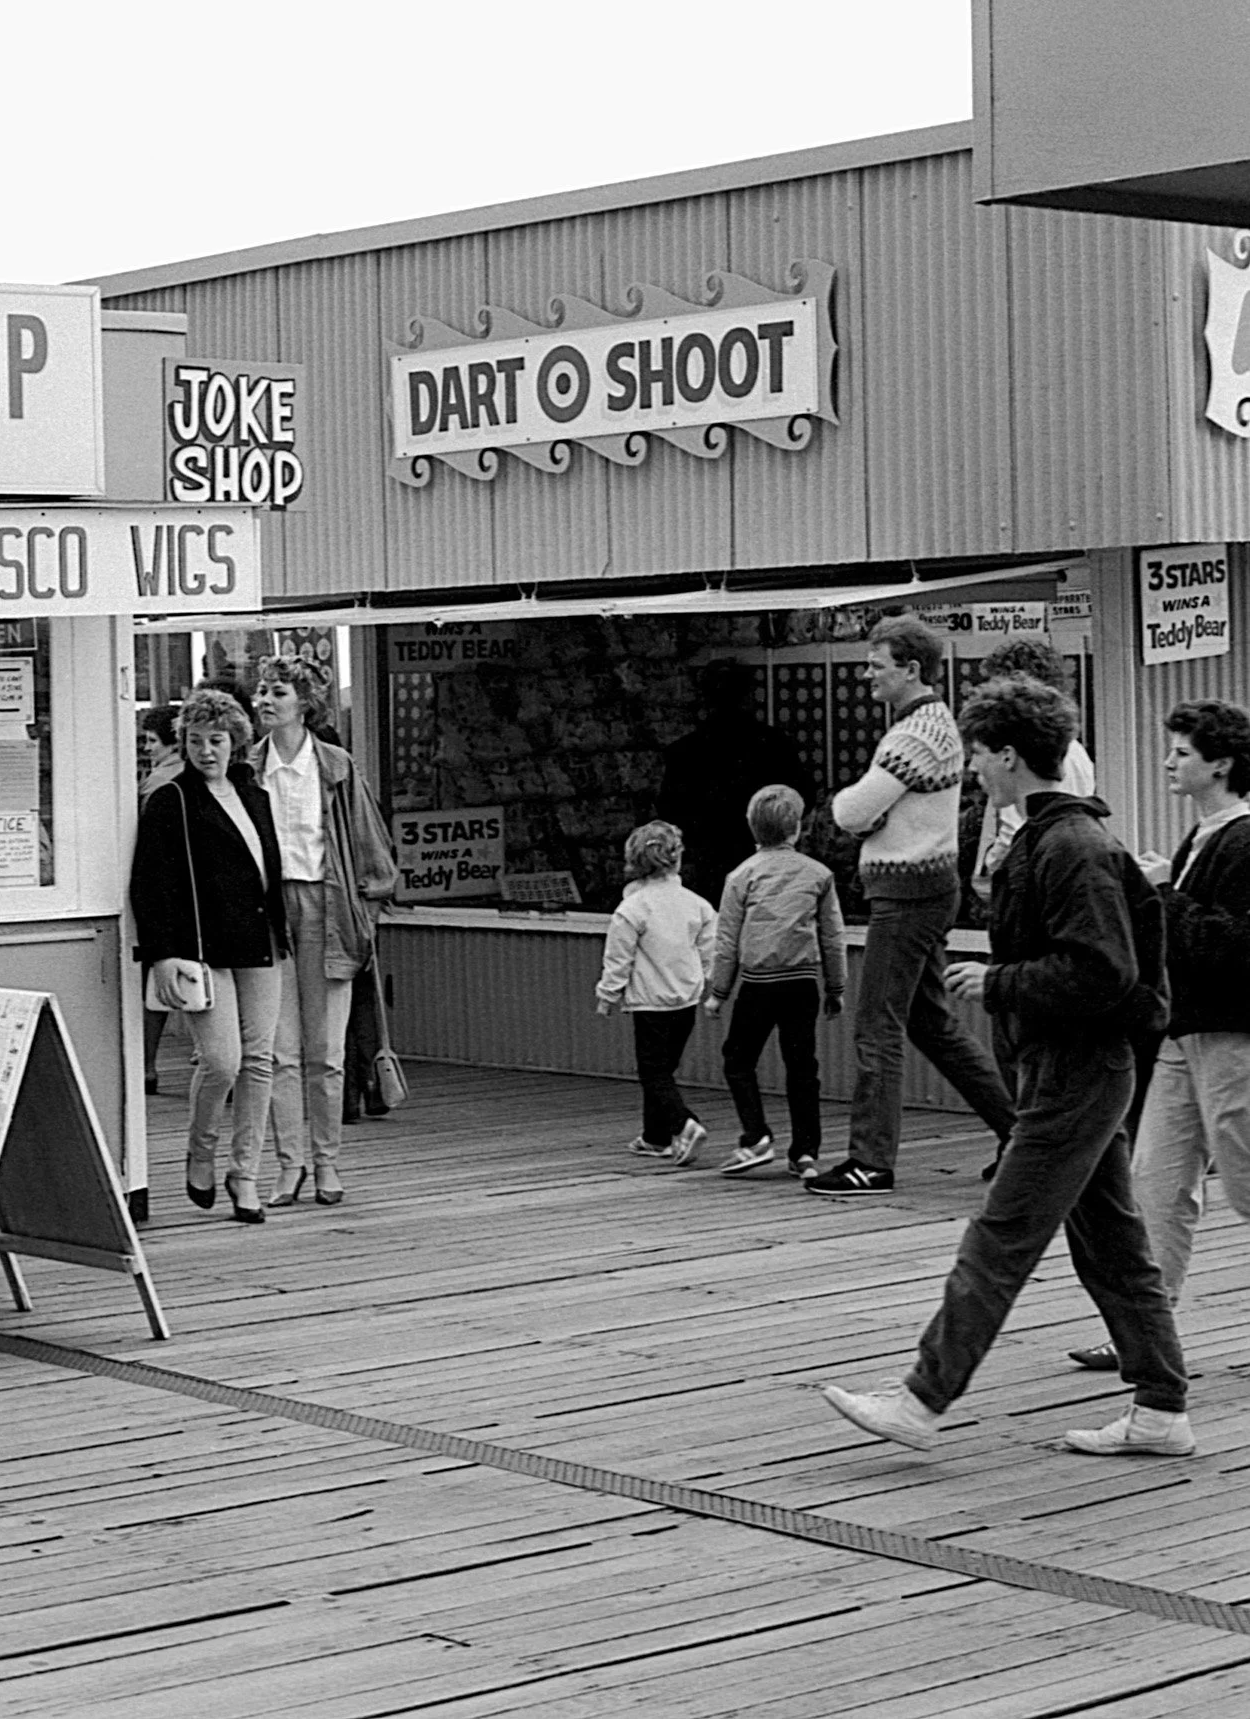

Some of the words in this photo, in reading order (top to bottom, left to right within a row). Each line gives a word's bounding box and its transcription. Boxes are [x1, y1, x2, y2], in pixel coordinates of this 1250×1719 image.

[408, 356, 525, 436] DART
[605, 319, 795, 412] SHOOT
[169, 366, 296, 447] JOKE
[170, 445, 304, 508] SHOP
[130, 523, 236, 597] WIGS
[1147, 561, 1164, 591] 3
[1165, 559, 1226, 589] STARS
[1162, 596, 1200, 612] WINS
[1201, 595, 1211, 607] A
[948, 612, 973, 631] 30
[976, 615, 1010, 635] Teddy
[1012, 614, 1043, 631] Bear
[1146, 620, 1194, 650] Teddy
[1195, 614, 1227, 638] Bear
[394, 640, 457, 661] TEDDY
[461, 639, 517, 660] BEAR
[401, 822, 419, 845] 3
[422, 818, 500, 844] STARS
[421, 848, 460, 861] WINS
[461, 848, 473, 858] A
[401, 865, 453, 891] Teddy
[456, 861, 501, 881] Bear
